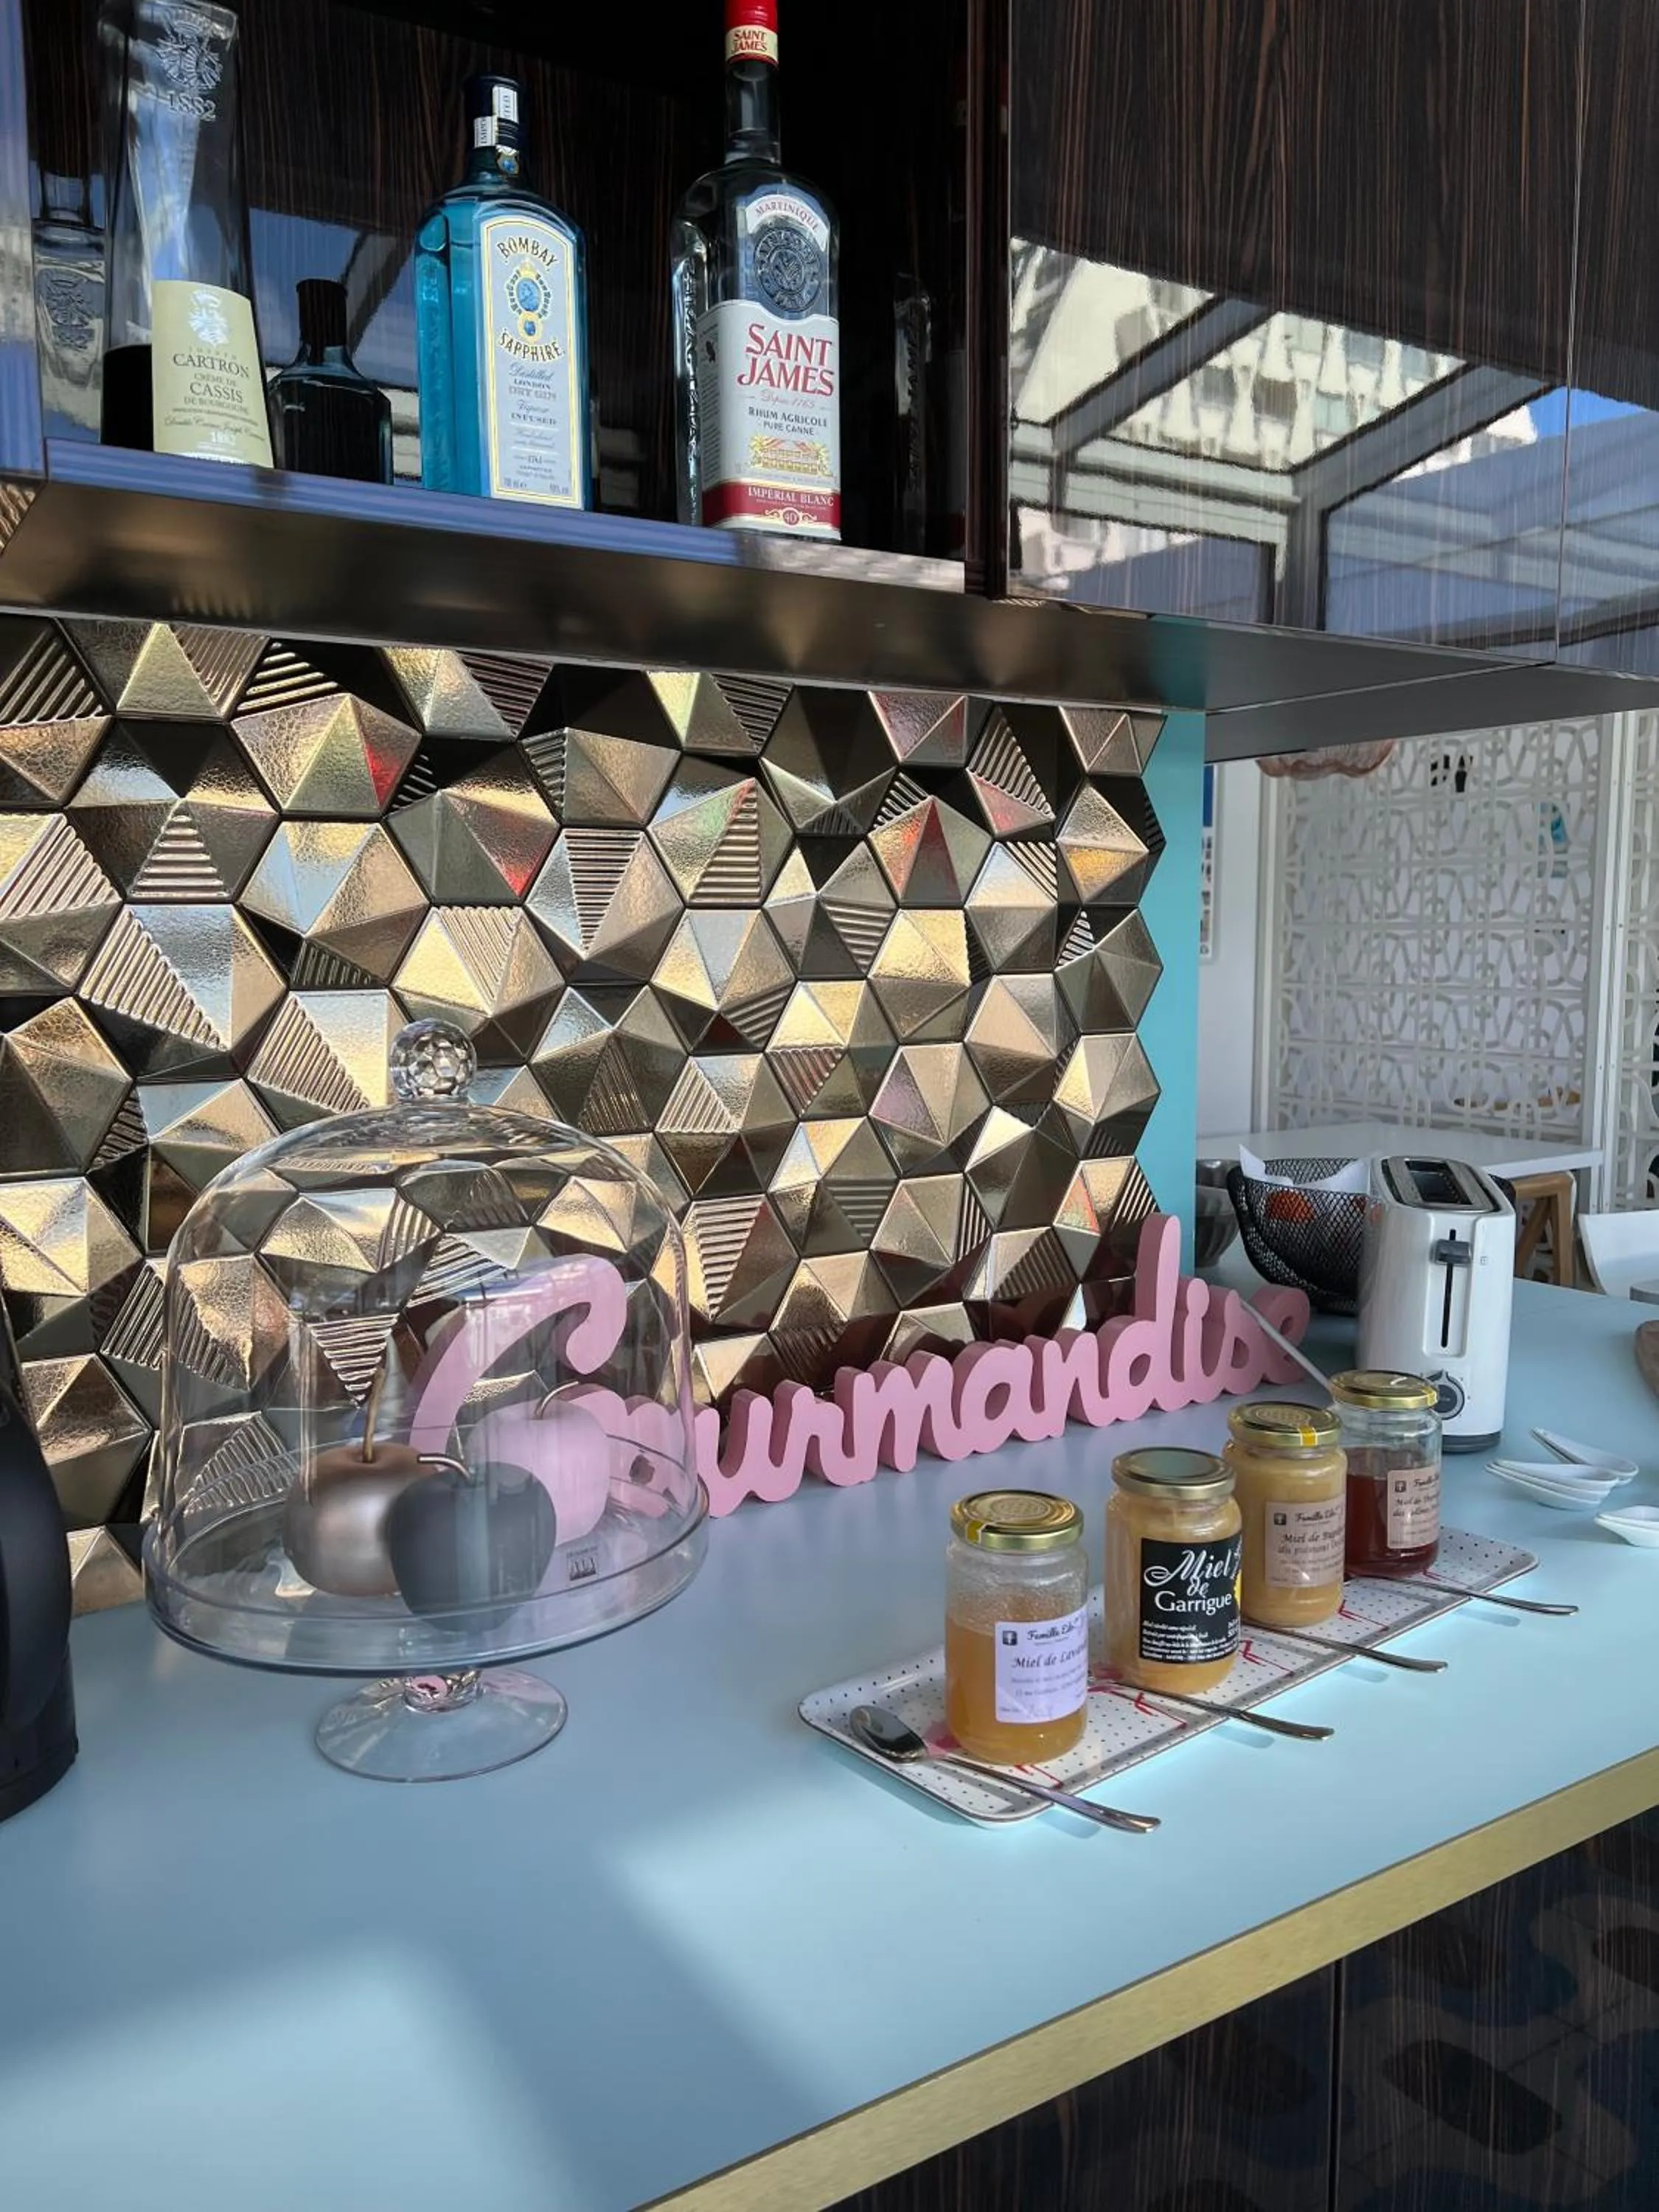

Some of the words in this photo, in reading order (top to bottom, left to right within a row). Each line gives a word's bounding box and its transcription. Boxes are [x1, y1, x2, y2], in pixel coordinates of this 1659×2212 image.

[732, 29, 768, 41] SAINT
[731, 40, 768, 55] JAMES
[755, 201, 819, 231] MARTINIQUE
[496, 236, 559, 268] BOMBAY
[499, 331, 563, 363] SAPPHIRE
[745, 323, 832, 366] SAINT
[173, 352, 251, 378] CARTRON
[737, 356, 835, 397] JAMES
[189, 381, 244, 404] CASSIS
[748, 406, 779, 420] RHUM
[781, 412, 828, 428] AGRICOLE
[763, 421, 784, 432] PURE
[785, 425, 815, 436] CANNE
[800, 493, 835, 507] BLANC
[1144, 1548, 1232, 1587] Miel
[1186, 1576, 1210, 1599] de
[1154, 1590, 1233, 1615] Garrigue
[1027, 1626, 1060, 1641] Famille
[1011, 1654, 1041, 1669] Miel
[1043, 1653, 1057, 1666] de
